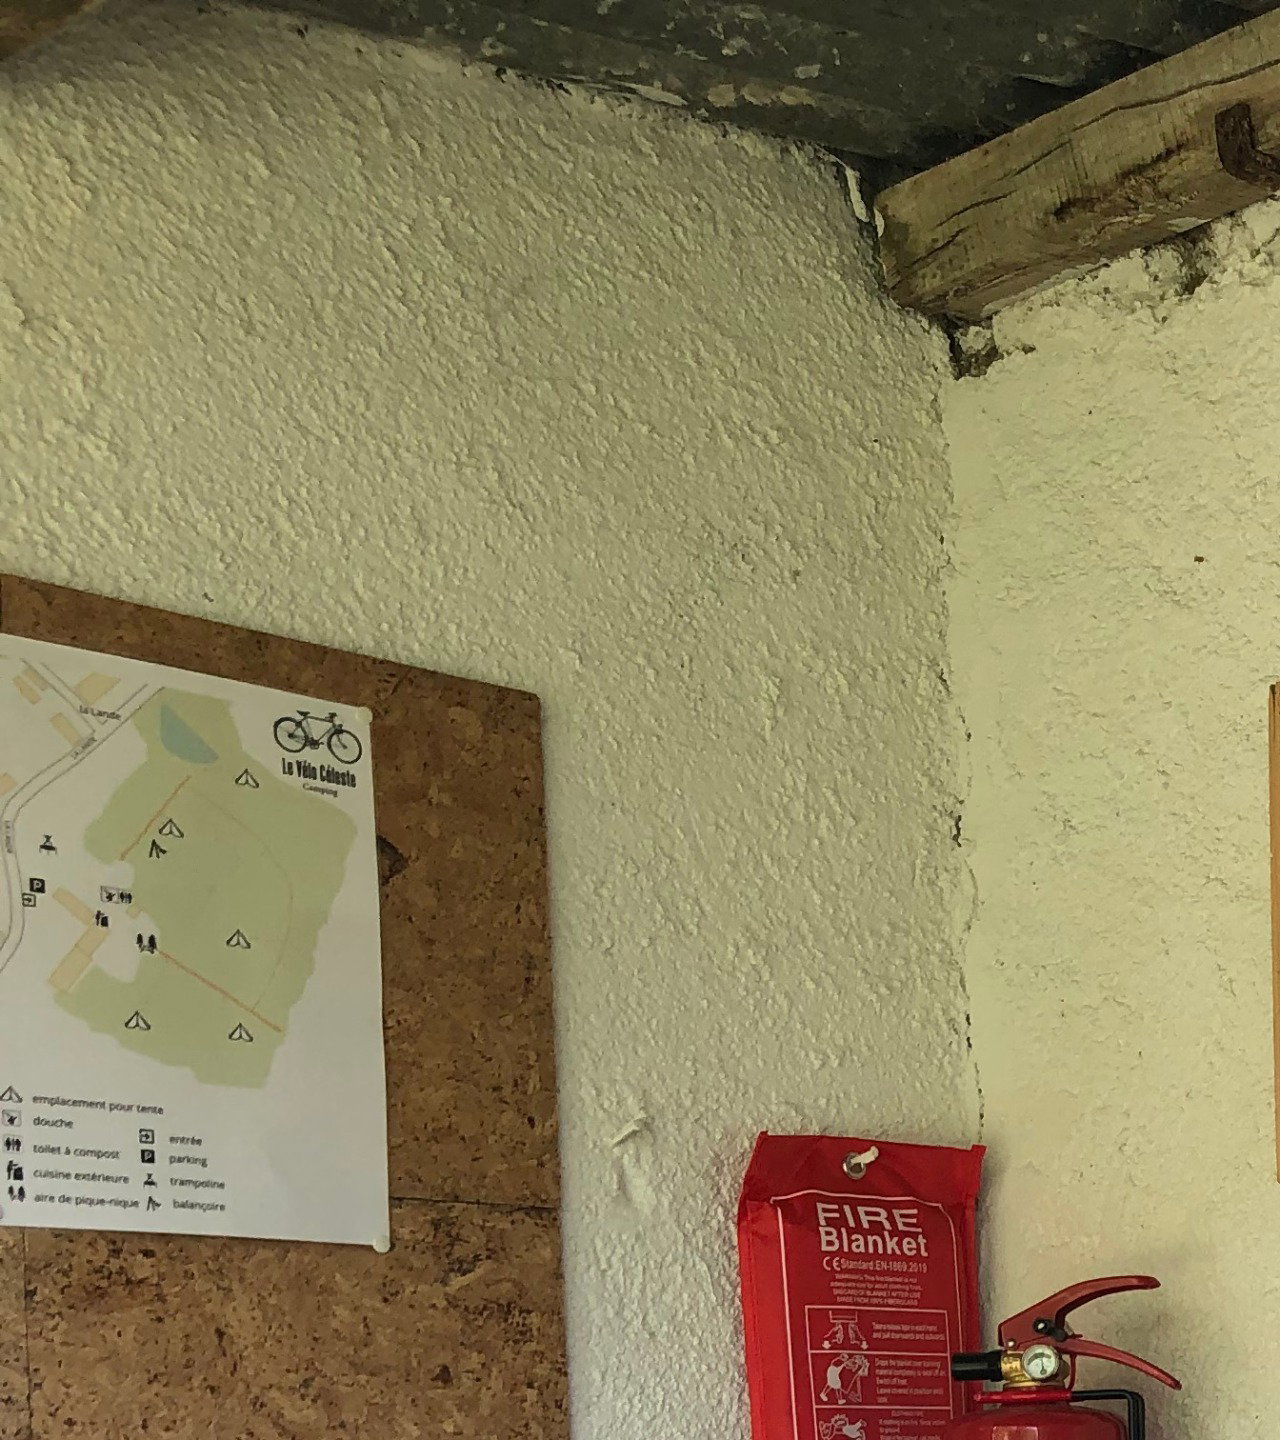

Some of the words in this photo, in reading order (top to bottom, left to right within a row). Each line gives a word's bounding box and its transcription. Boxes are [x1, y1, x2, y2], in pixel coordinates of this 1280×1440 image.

[281, 757, 294, 776] Le
[32, 1094, 106, 1111] emplacement
[109, 1102, 134, 1113] pour
[136, 1105, 164, 1115] tente
[32, 1115, 74, 1129] douche
[169, 1134, 203, 1146] entrée
[33, 1143, 61, 1156] toilet
[73, 1148, 120, 1160] compost
[168, 1154, 208, 1168] parking
[33, 1168, 72, 1180] cuisine
[169, 1176, 226, 1190] trampoline
[34, 1193, 55, 1204] aire
[57, 1193, 72, 1204] de
[75, 1196, 139, 1209] pique-nique
[173, 1199, 226, 1213] balançoire
[816, 1202, 923, 1233] FIRE
[818, 1226, 929, 1257] Blanket
